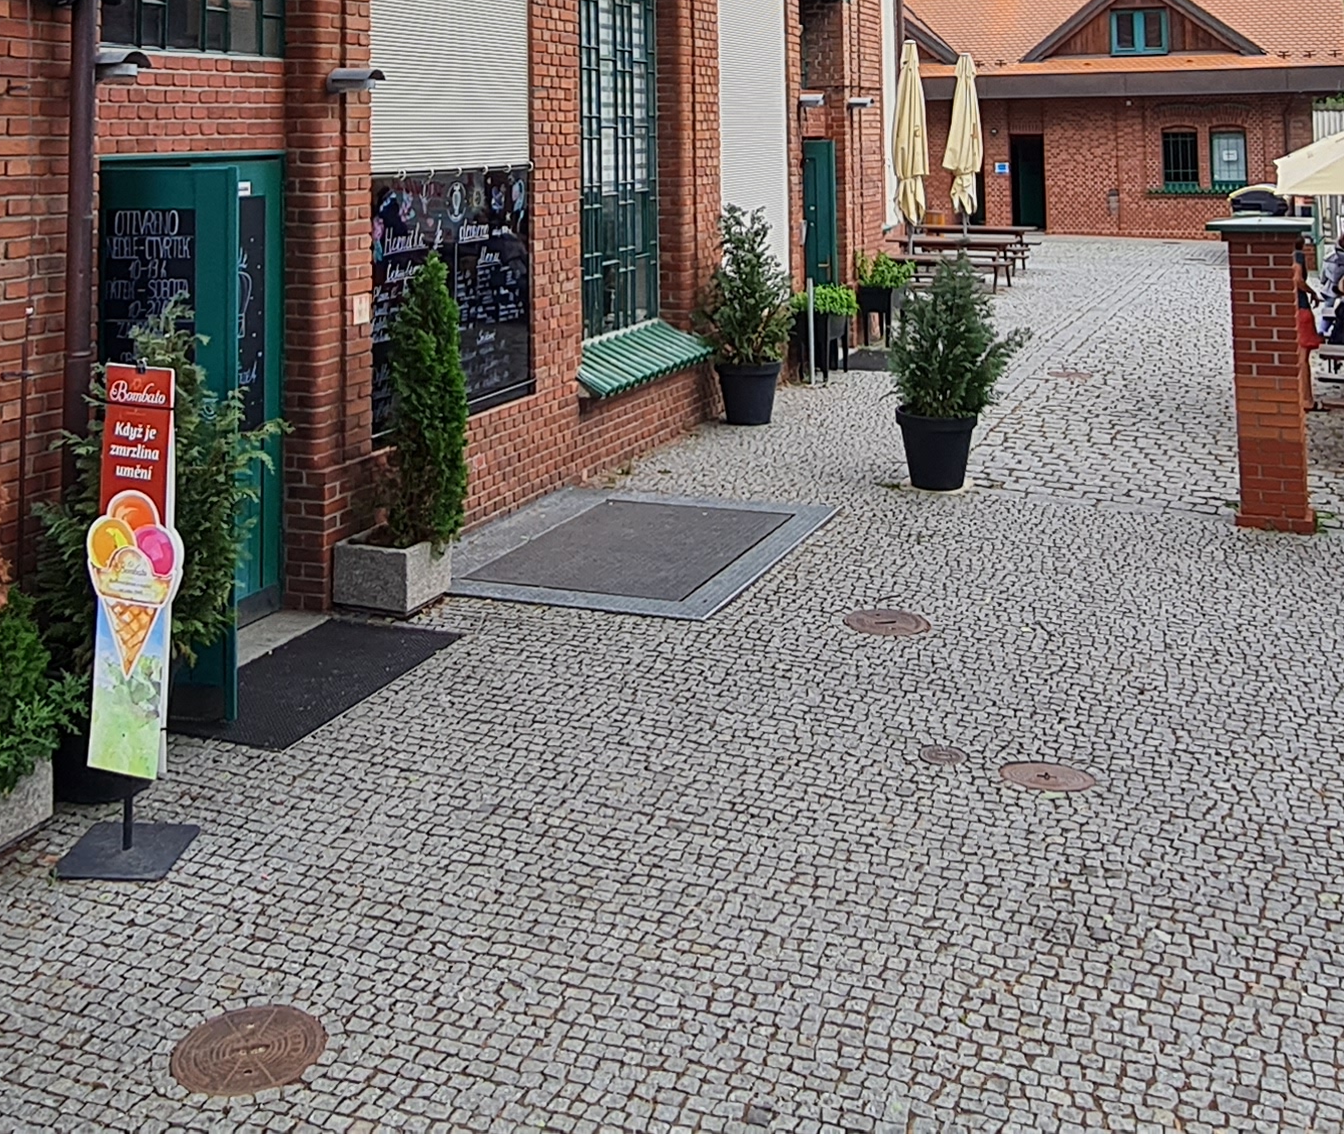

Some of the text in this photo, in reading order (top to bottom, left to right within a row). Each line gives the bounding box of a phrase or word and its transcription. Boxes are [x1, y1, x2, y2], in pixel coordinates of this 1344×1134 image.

[115, 421, 158, 443] Když je
[109, 443, 160, 462] zmrzlina
[115, 464, 154, 481] umění
